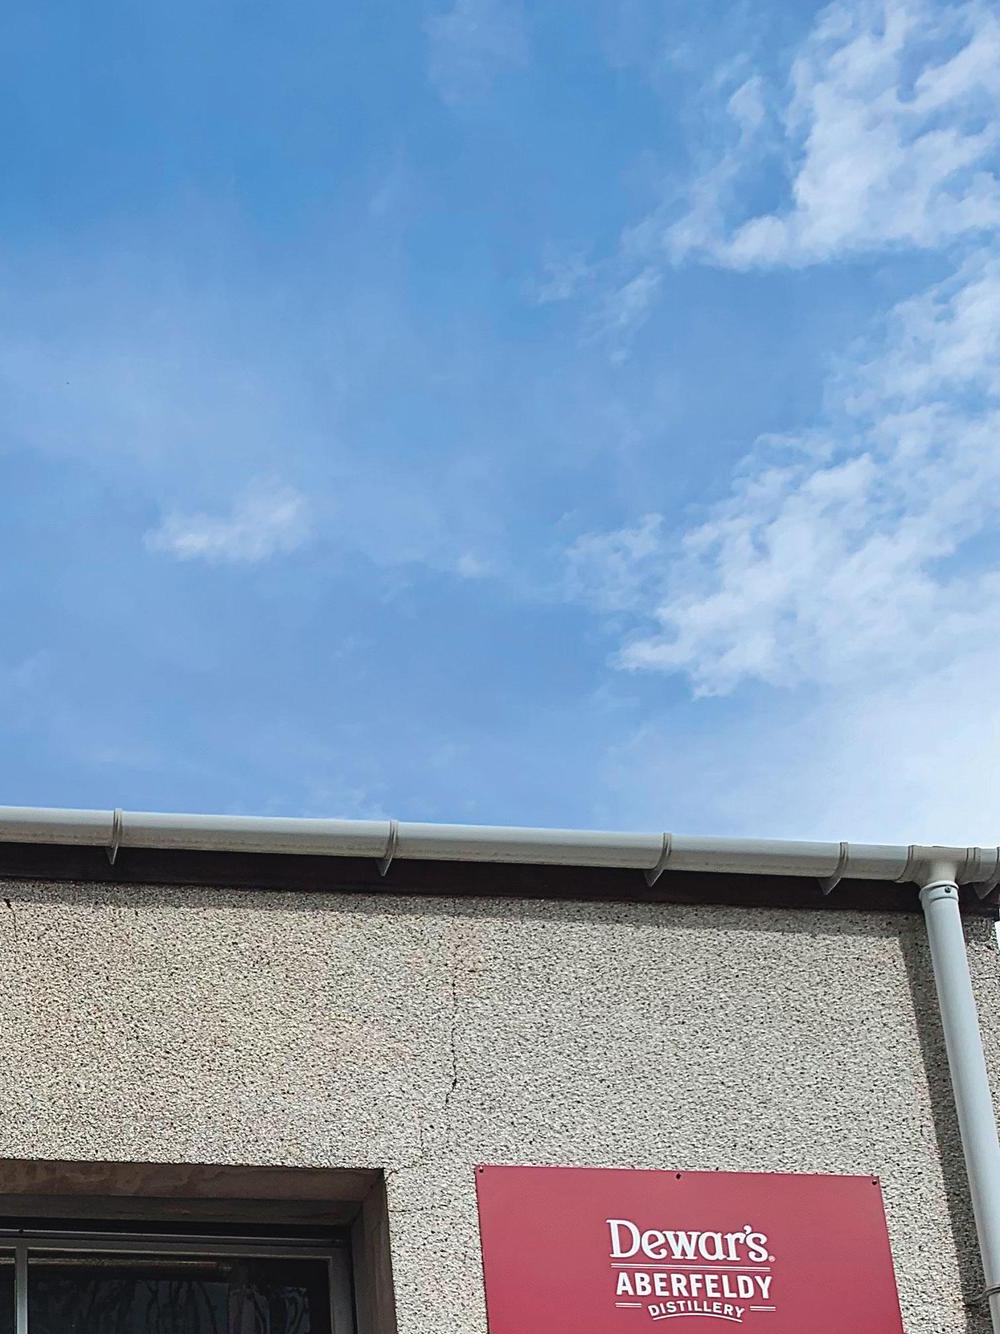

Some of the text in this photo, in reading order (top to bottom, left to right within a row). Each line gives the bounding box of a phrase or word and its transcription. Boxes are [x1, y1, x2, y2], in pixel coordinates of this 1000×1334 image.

[606, 1219, 768, 1262] Dewar's
[616, 1271, 773, 1299] ABERFELDY
[648, 1300, 746, 1319] DISTILLERY
